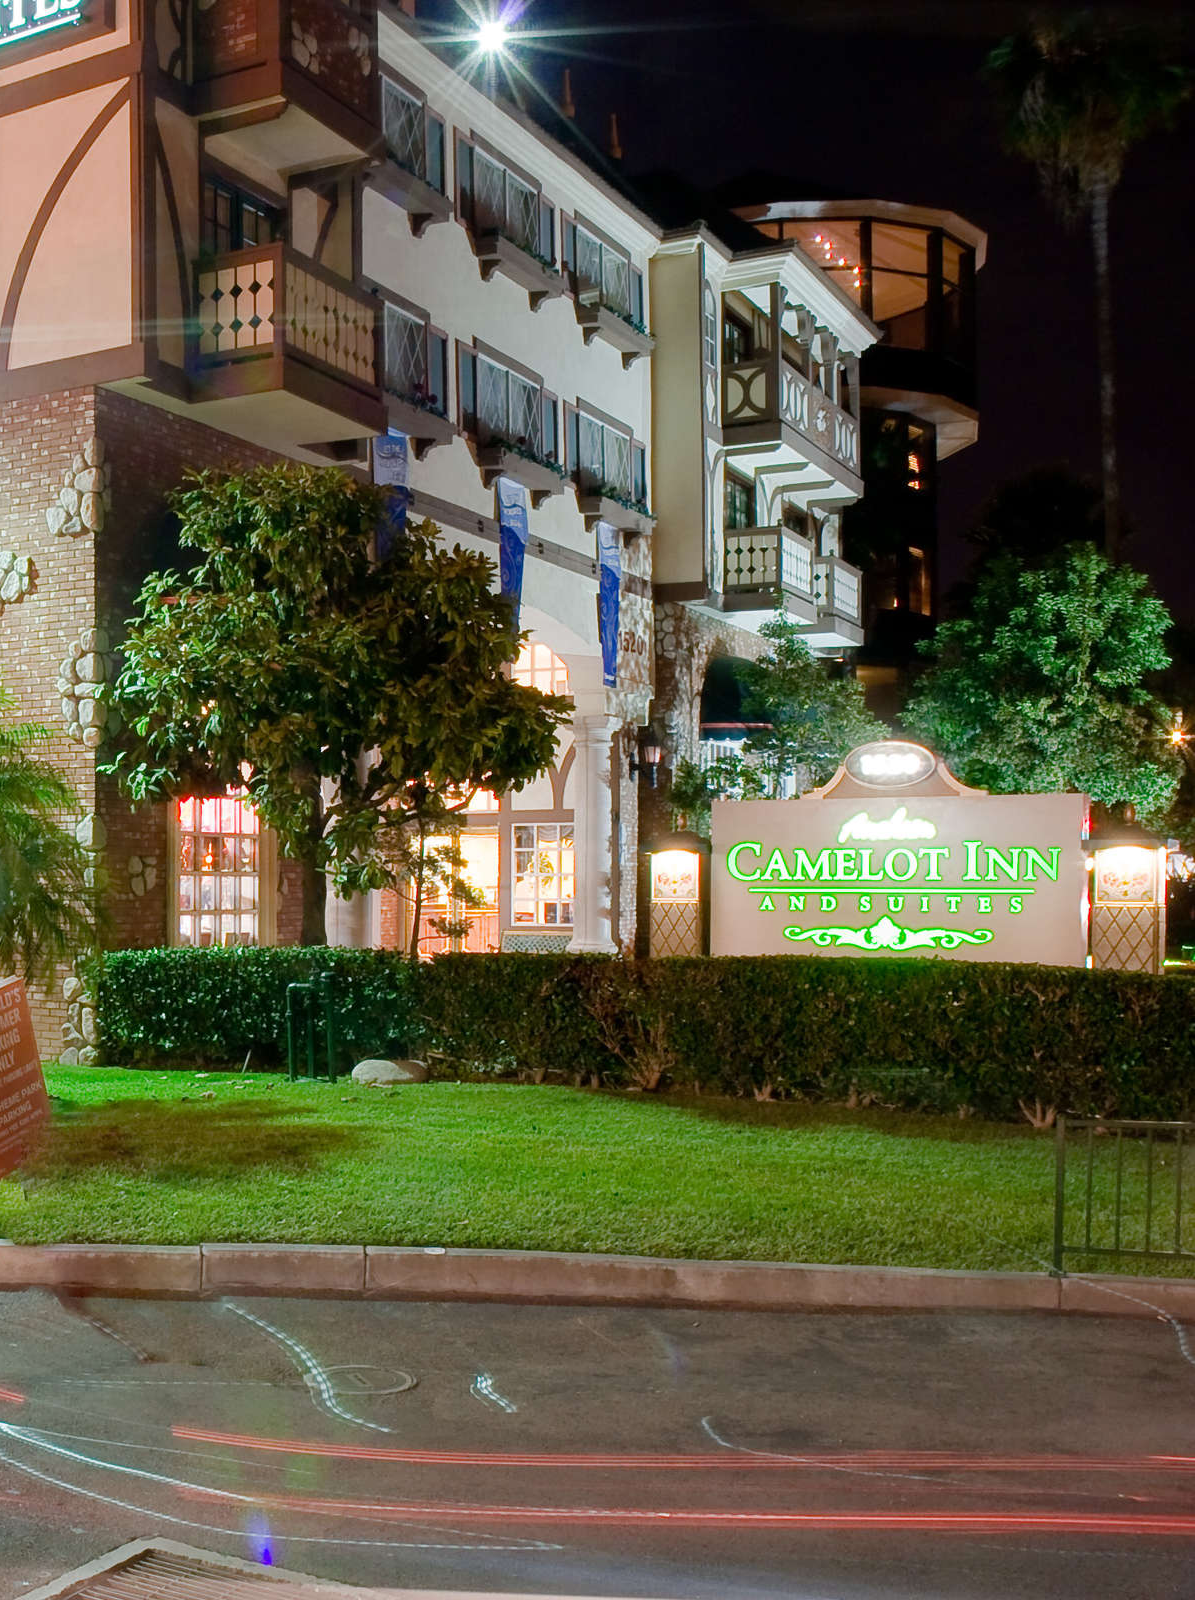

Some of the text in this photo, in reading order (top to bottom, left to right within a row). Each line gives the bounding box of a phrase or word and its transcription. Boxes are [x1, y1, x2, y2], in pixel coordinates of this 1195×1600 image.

[726, 840, 1062, 882] CAMELOT INN
[759, 895, 1024, 914] AND SUITES
[21, 1080, 43, 1098] PARK
